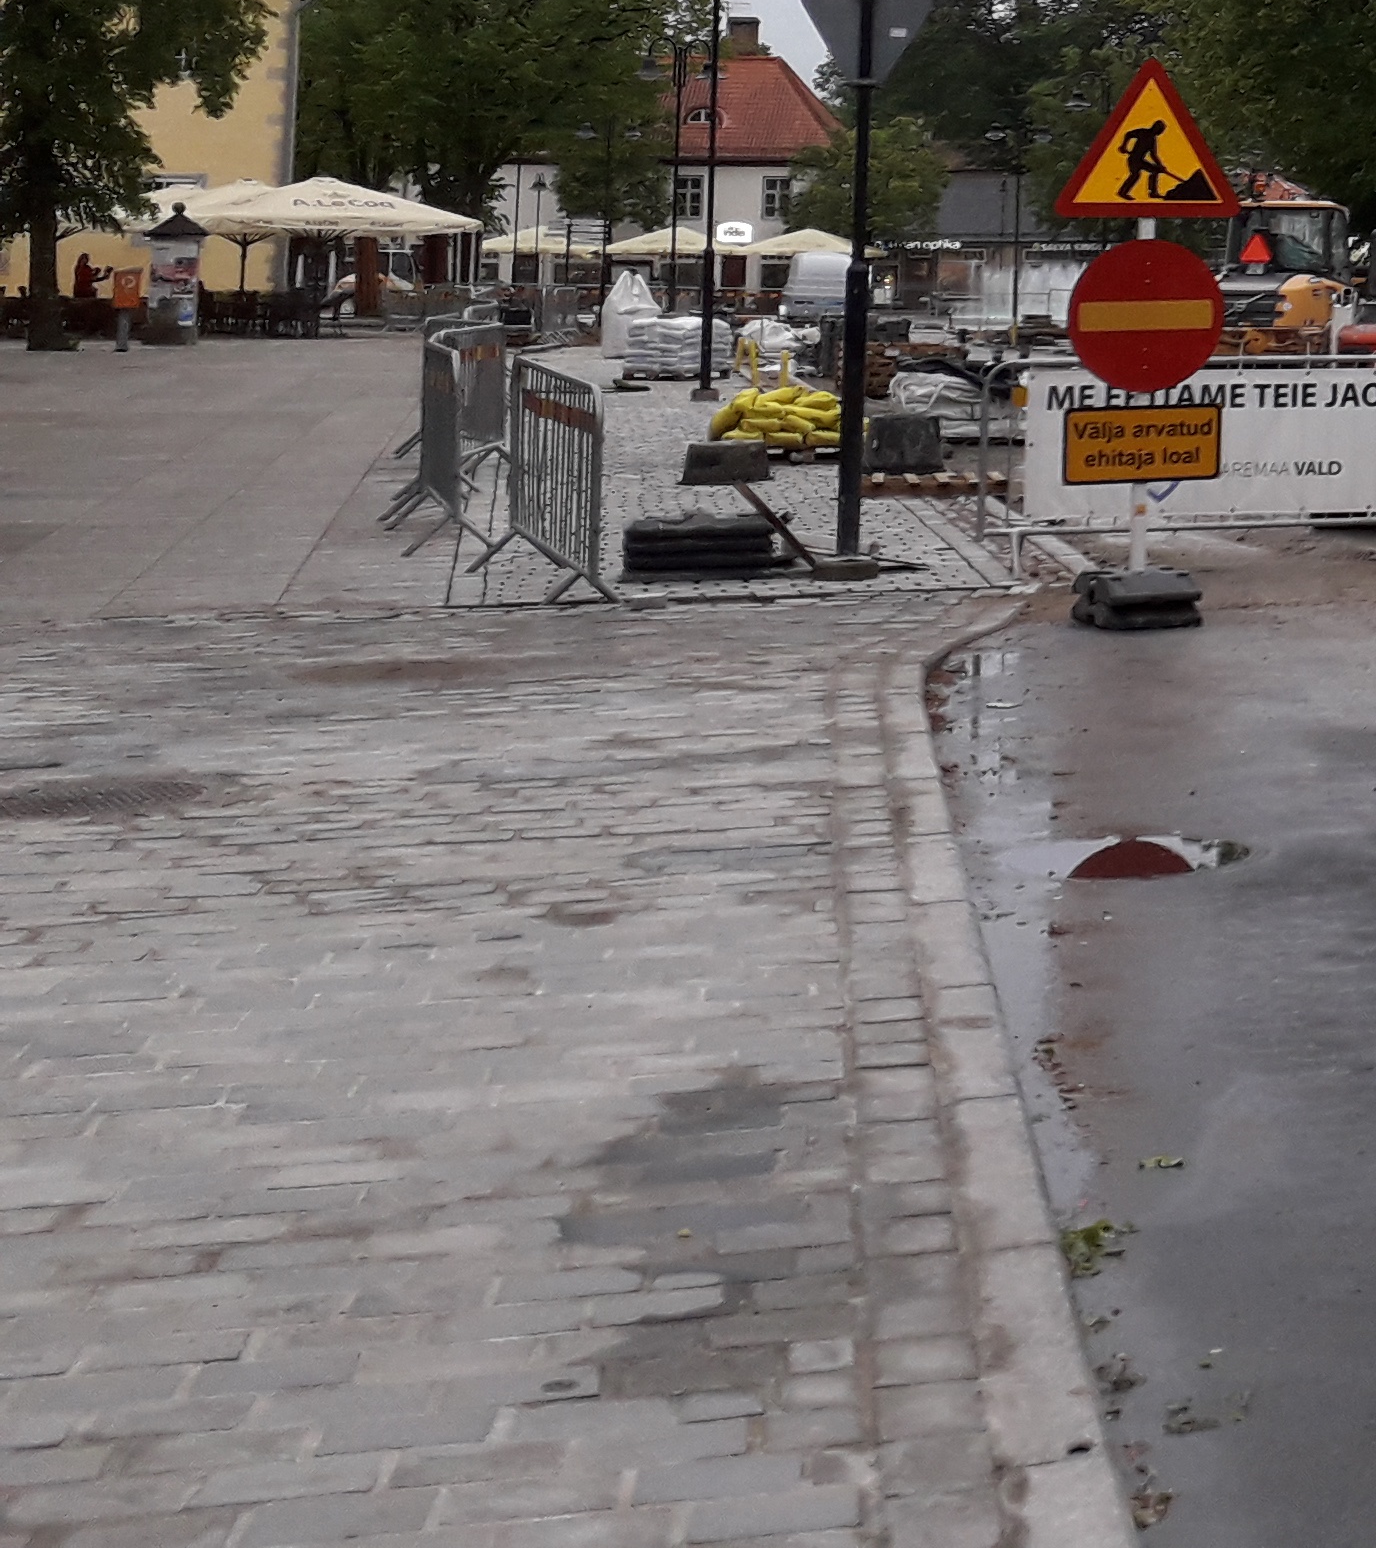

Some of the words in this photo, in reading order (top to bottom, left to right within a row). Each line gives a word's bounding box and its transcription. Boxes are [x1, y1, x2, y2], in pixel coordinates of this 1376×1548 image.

[1047, 384, 1095, 410] ME
[1254, 383, 1317, 408] TEIE
[1073, 420, 1125, 444] Välja
[1133, 418, 1213, 438] arvatud
[1084, 449, 1155, 471] ehitaja
[1161, 446, 1201, 465] loal
[1293, 460, 1342, 476] VALD
